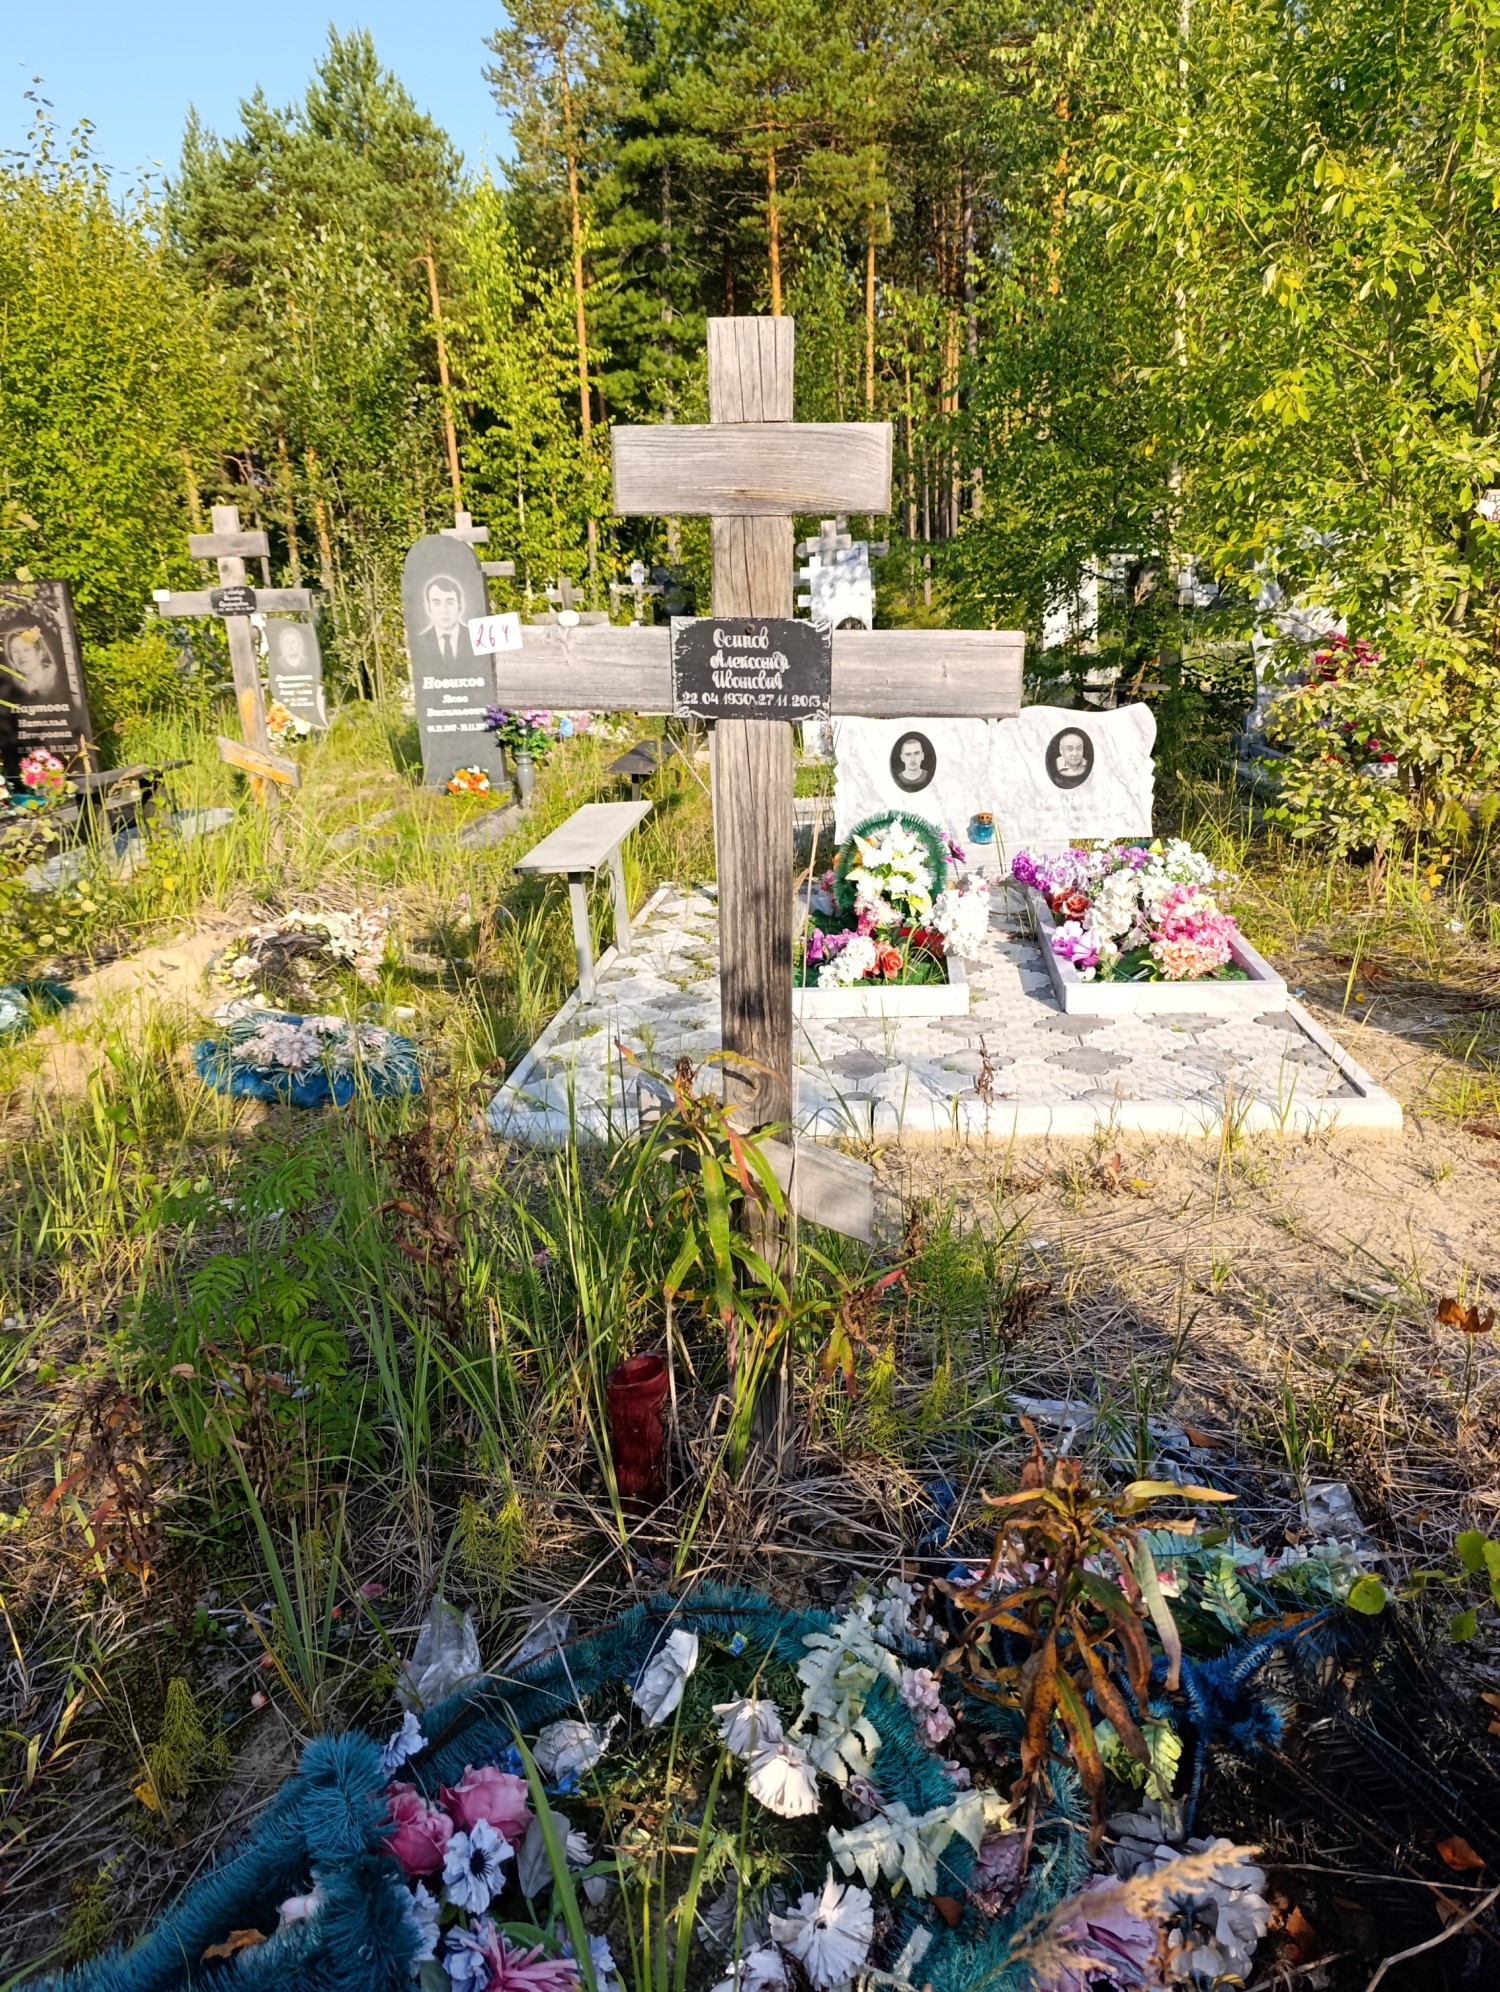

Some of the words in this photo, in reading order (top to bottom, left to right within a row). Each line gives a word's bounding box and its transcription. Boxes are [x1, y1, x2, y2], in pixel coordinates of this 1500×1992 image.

[713, 626, 769, 650] Осипов
[710, 650, 790, 673] Александр
[423, 677, 485, 689] Новиков
[711, 669, 784, 690] Иванович
[18, 719, 67, 727] Наталья
[18, 731, 72, 740] Петровна
